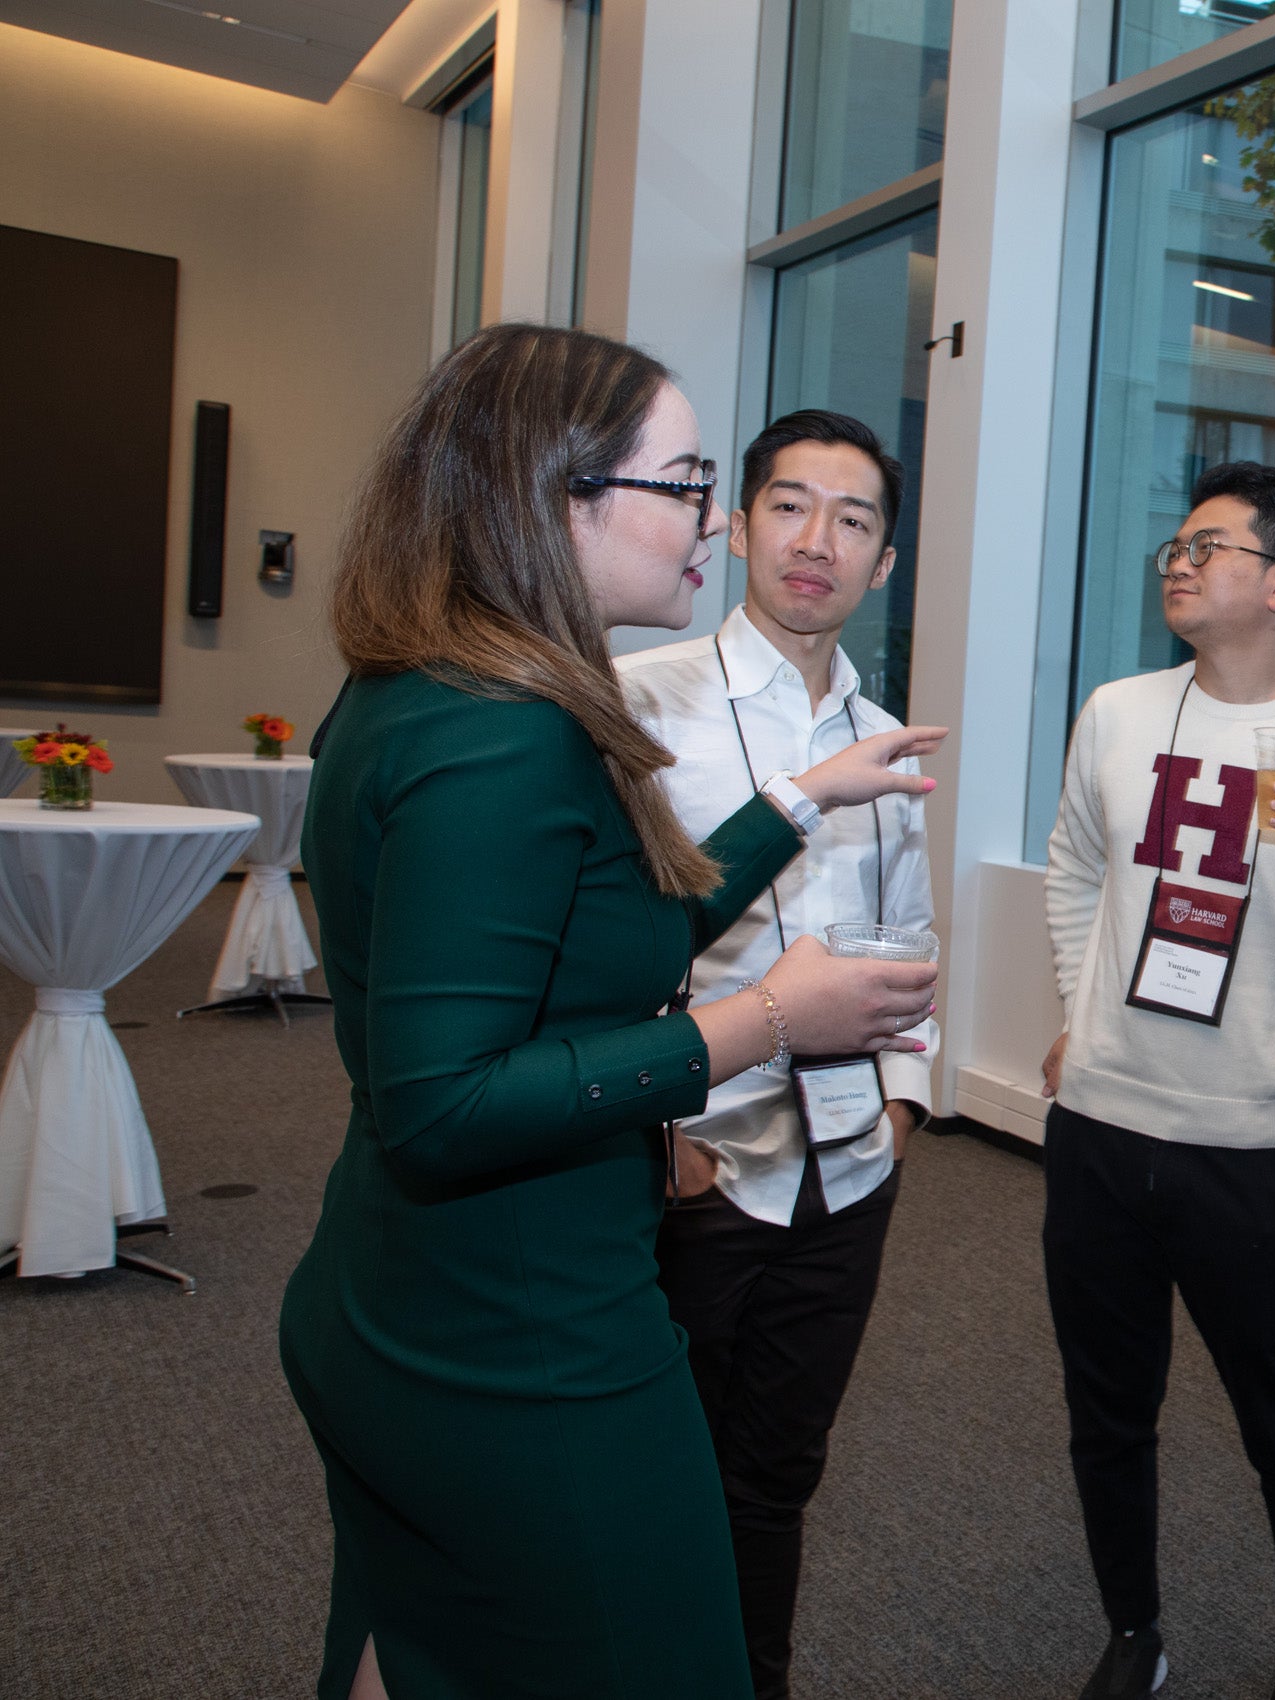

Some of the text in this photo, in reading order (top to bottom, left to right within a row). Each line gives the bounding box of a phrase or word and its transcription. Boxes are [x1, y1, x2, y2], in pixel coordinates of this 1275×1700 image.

[1133, 753, 1258, 885] H
[1191, 907, 1227, 922] HARVARD
[1203, 917, 1225, 929] SCHOOL
[1167, 960, 1201, 977] Yunxiang
